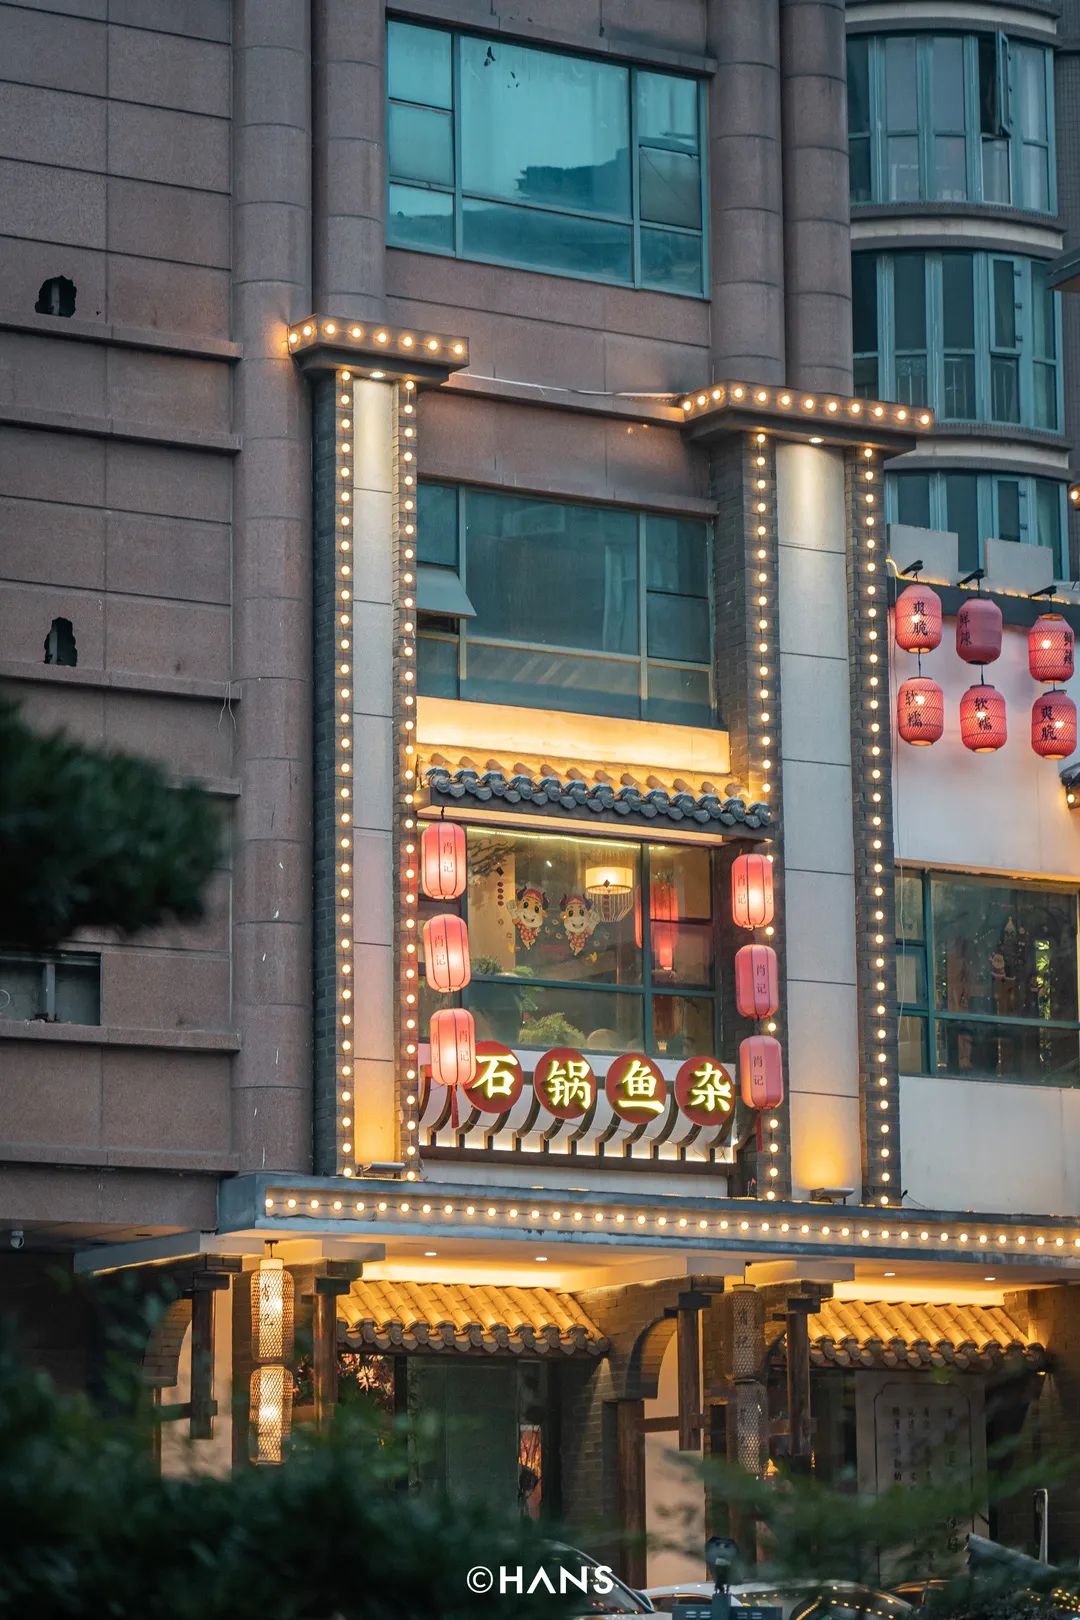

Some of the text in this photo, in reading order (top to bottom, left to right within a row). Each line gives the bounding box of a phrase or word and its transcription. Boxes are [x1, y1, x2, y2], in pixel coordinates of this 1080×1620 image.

[756, 964, 767, 994] 肖记
[471, 1054, 732, 1114] 石锅鱼杂
[753, 1055, 764, 1087] 肖记
